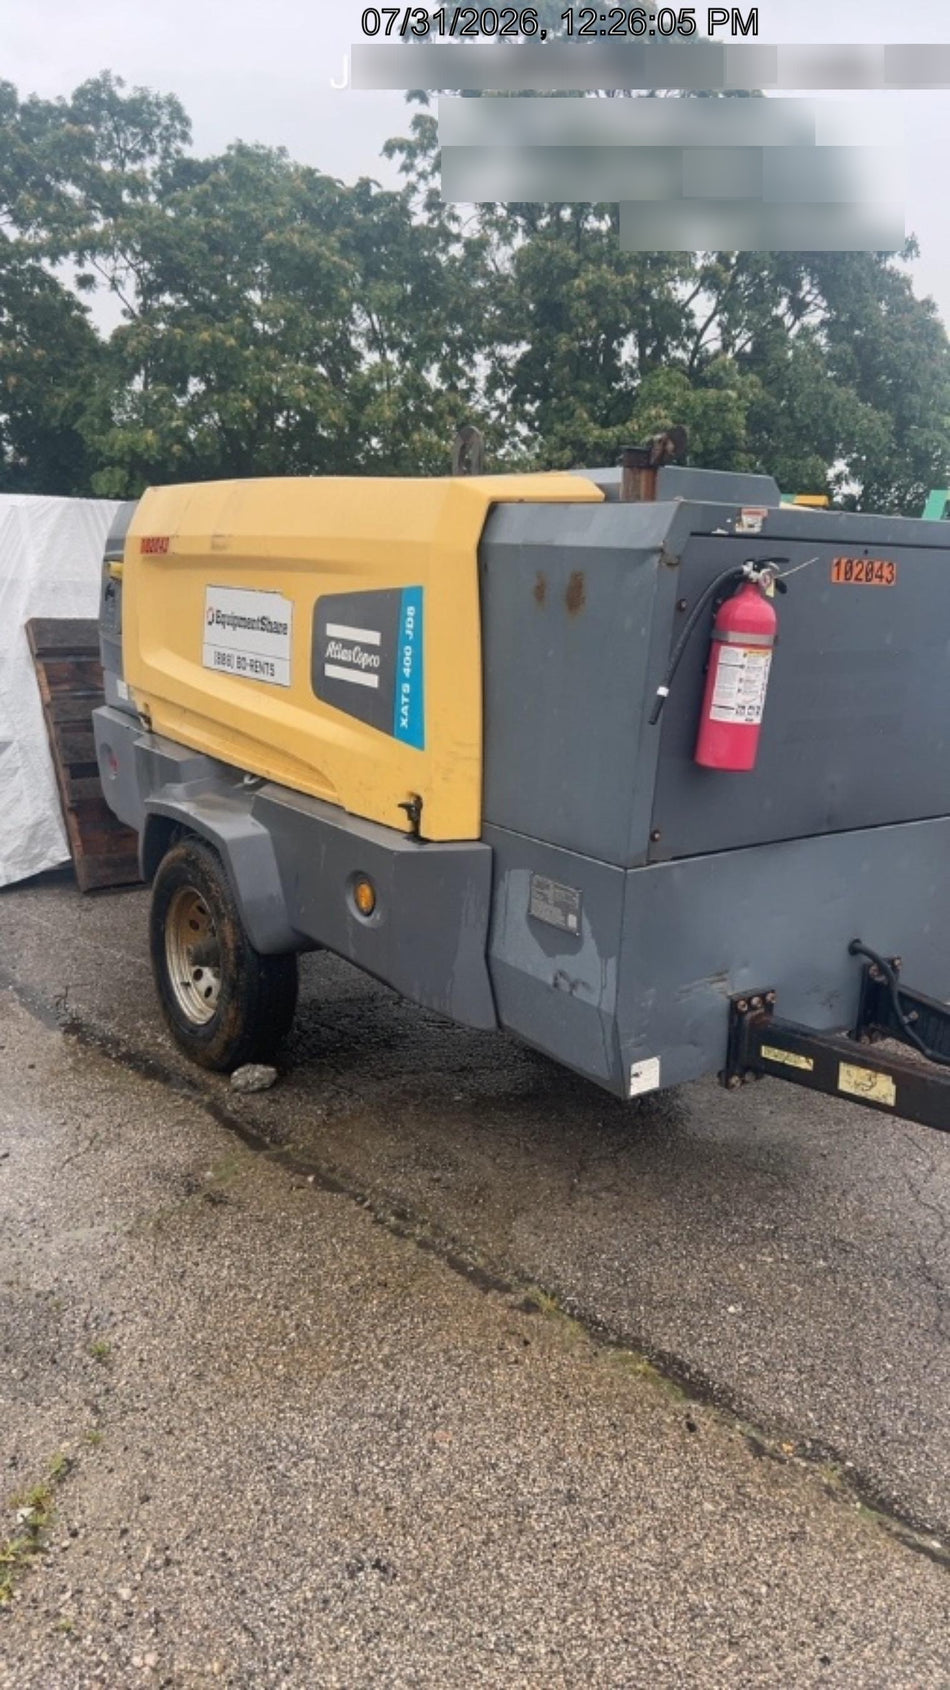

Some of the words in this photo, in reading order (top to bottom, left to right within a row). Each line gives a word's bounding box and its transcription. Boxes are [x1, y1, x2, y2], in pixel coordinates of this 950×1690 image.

[834, 558, 895, 584] 102043
[215, 609, 288, 635] EquipmentShare
[403, 645, 413, 678] 400
[400, 683, 411, 729] XATS
